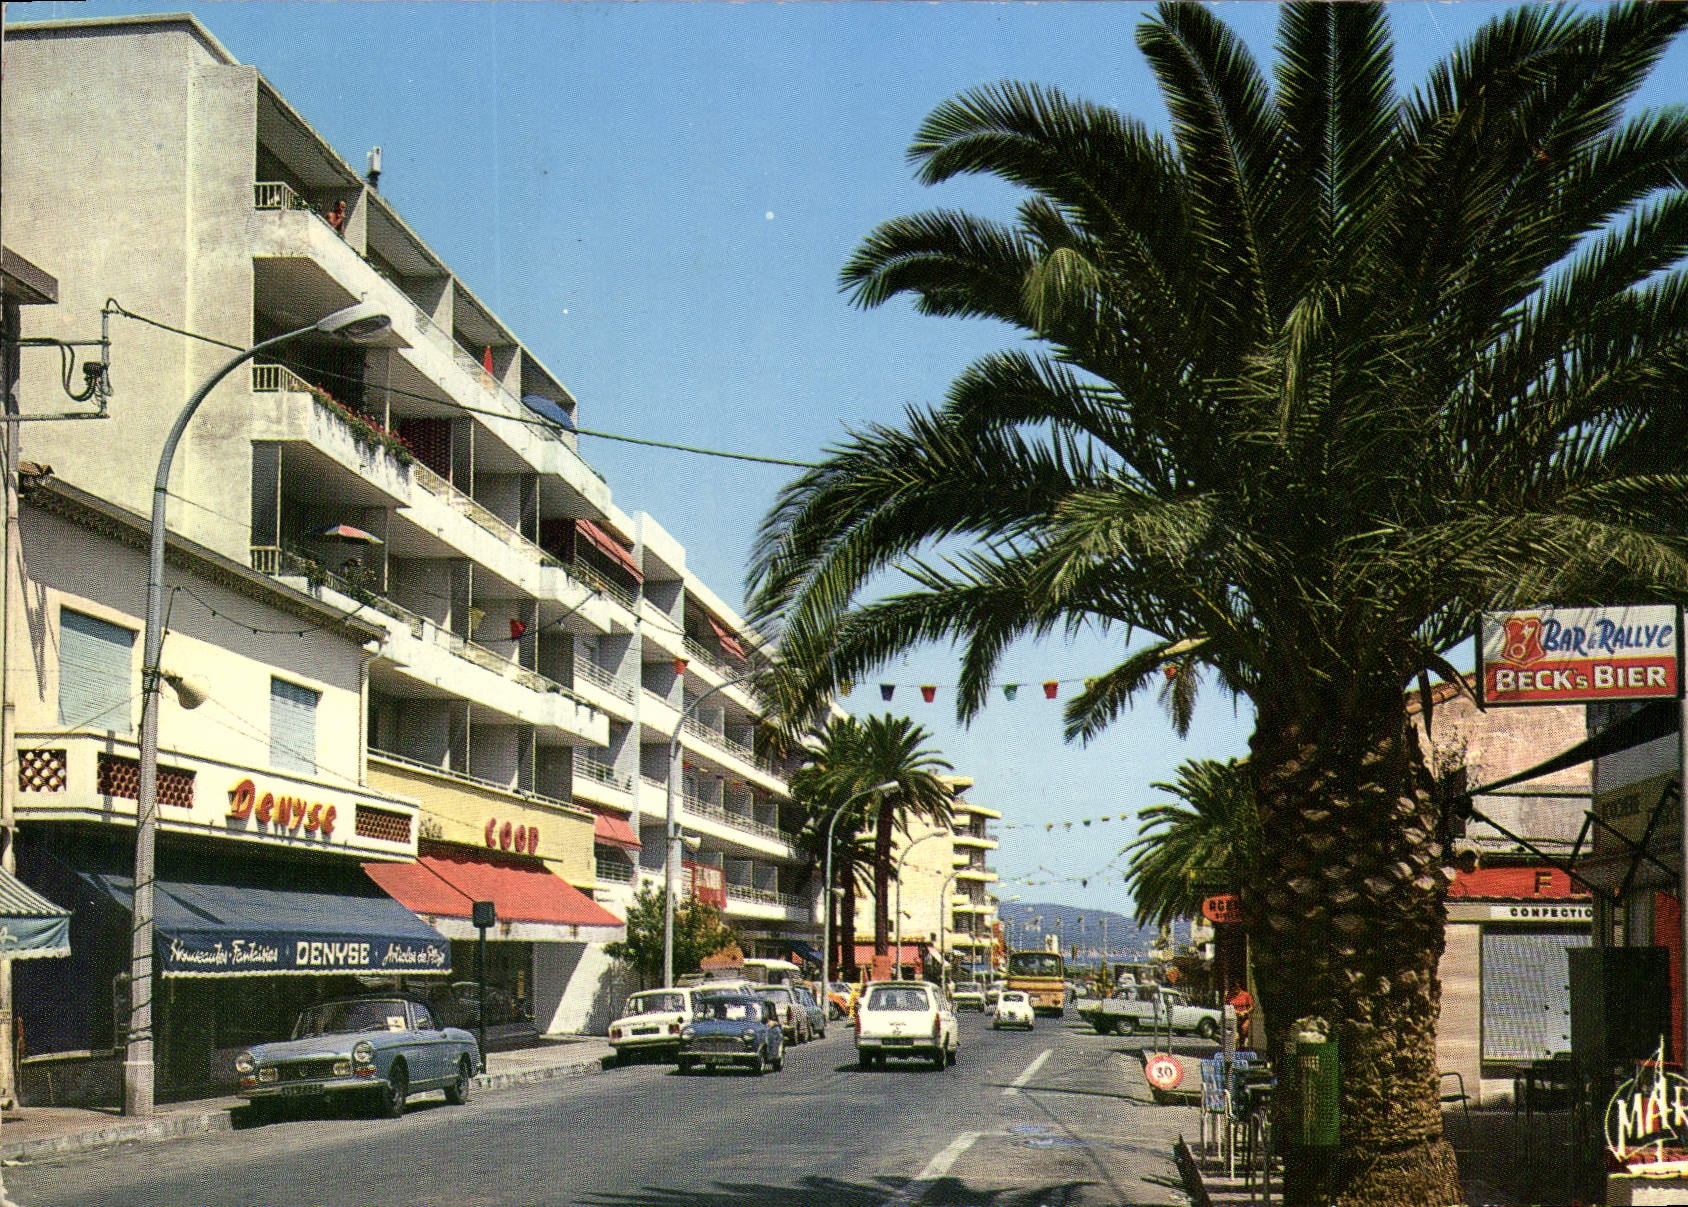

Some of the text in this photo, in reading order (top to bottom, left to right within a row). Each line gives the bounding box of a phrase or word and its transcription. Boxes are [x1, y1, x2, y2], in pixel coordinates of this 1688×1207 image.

[1593, 664, 1667, 689] BIER
[485, 817, 539, 855] COOP
[296, 941, 370, 965] DENYSE
[1156, 1066, 1173, 1079] 30
